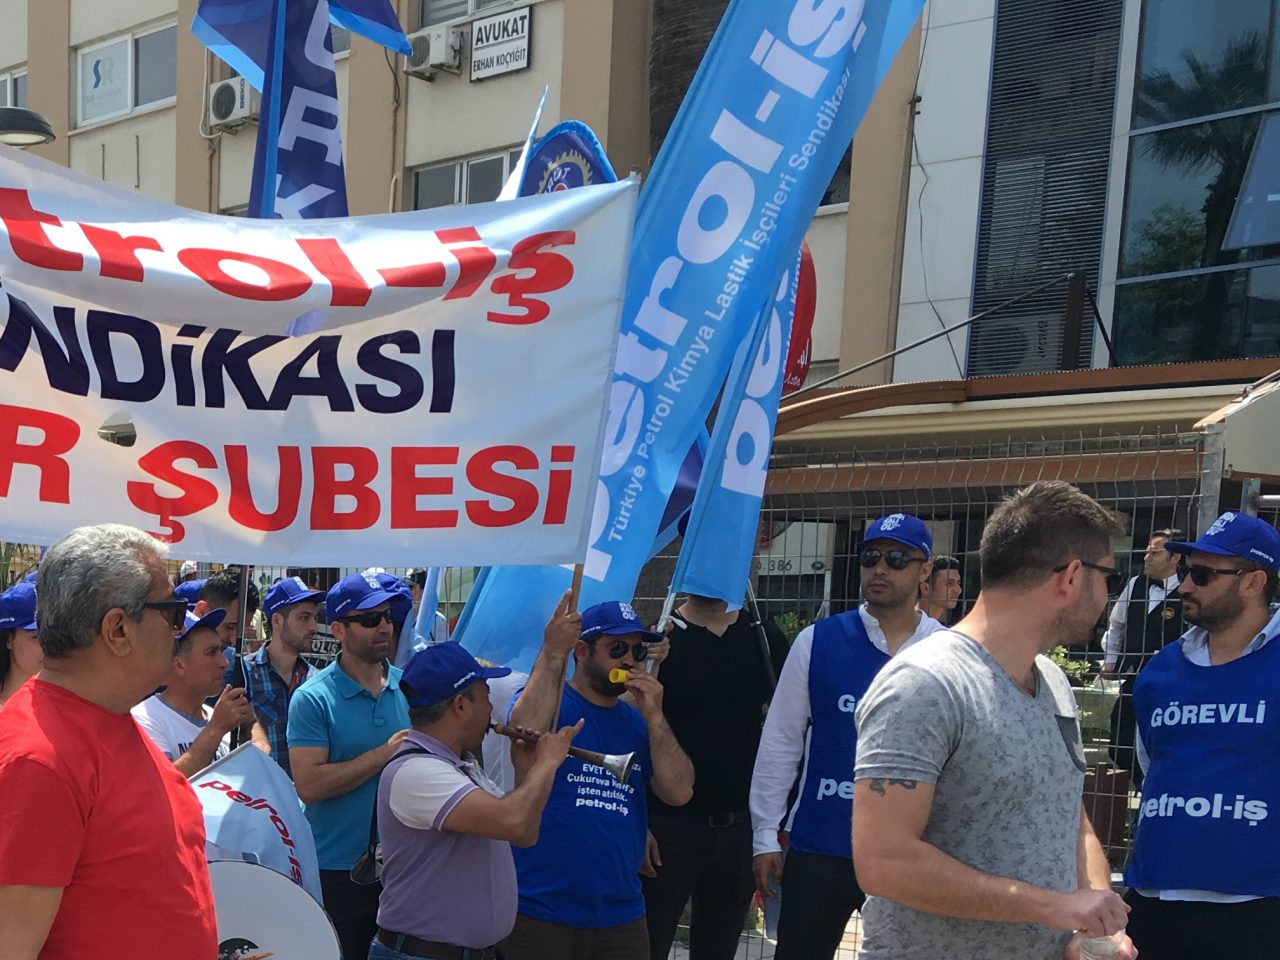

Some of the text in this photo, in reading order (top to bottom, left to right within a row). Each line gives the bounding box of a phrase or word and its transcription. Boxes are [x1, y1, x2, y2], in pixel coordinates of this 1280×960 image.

[475, 15, 527, 47] AVUKAT
[473, 57, 494, 73] ERHAN
[608, 463, 647, 542] Türkiye
[637, 395, 675, 462] Petrol
[664, 326, 716, 394] Kimya
[704, 254, 754, 323] Lastik
[788, 66, 851, 172] Sendikası
[770, 560, 793, 572] 386
[582, 763, 604, 775] EVET
[566, 773, 610, 787] Çukurova
[575, 798, 629, 816] petrol-iş
